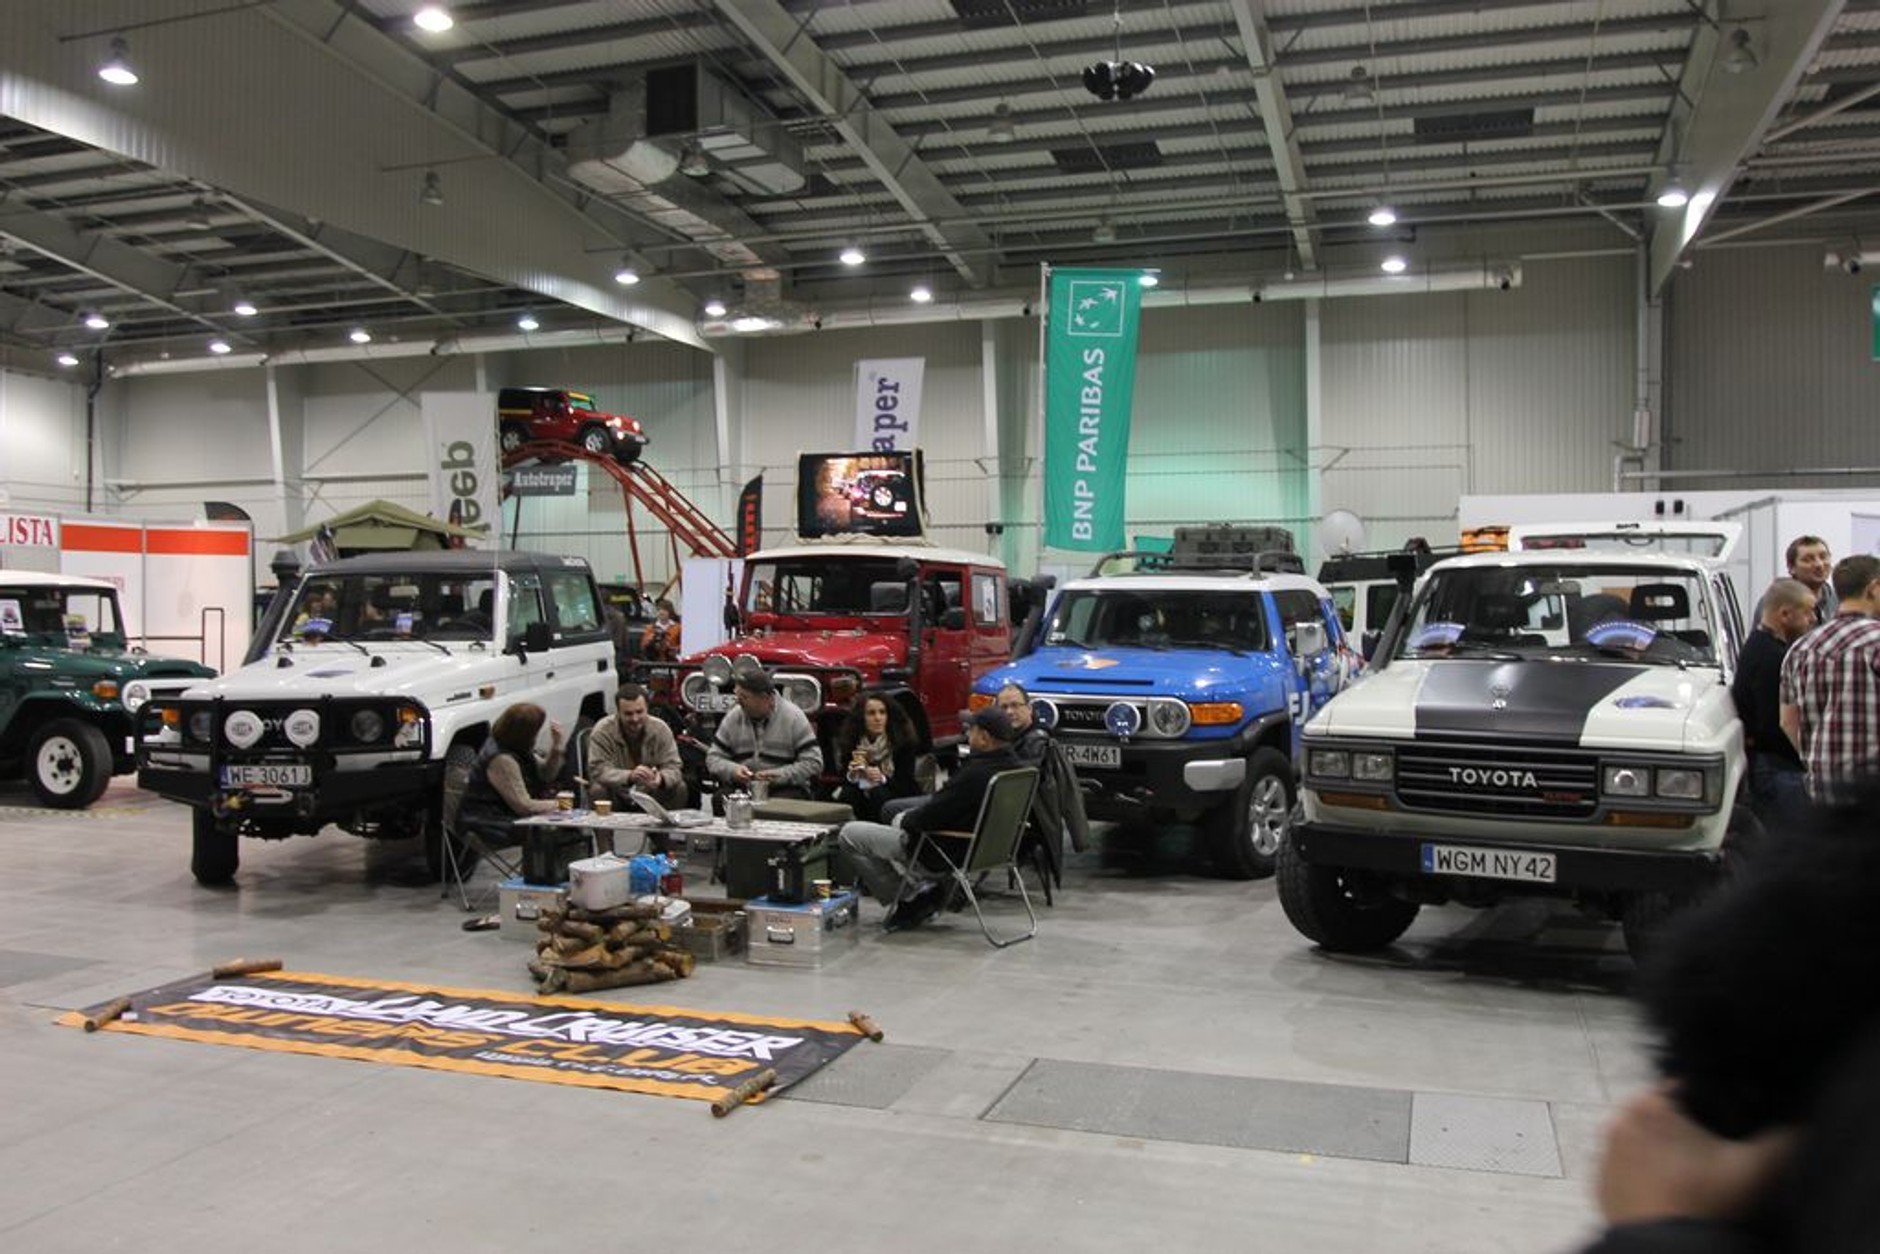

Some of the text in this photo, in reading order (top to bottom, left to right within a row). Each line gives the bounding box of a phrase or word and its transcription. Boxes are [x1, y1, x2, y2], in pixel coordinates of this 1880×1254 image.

[1072, 347, 1105, 541] BNP PARIBAS
[1288, 690, 1310, 726] FJ
[230, 767, 253, 783] WE
[1449, 767, 1538, 788] TOYOTA
[1436, 849, 1487, 873] WGM
[216, 987, 804, 1062] TOYOTA LAND CRUISER
[496, 1038, 761, 1077] CLUB
